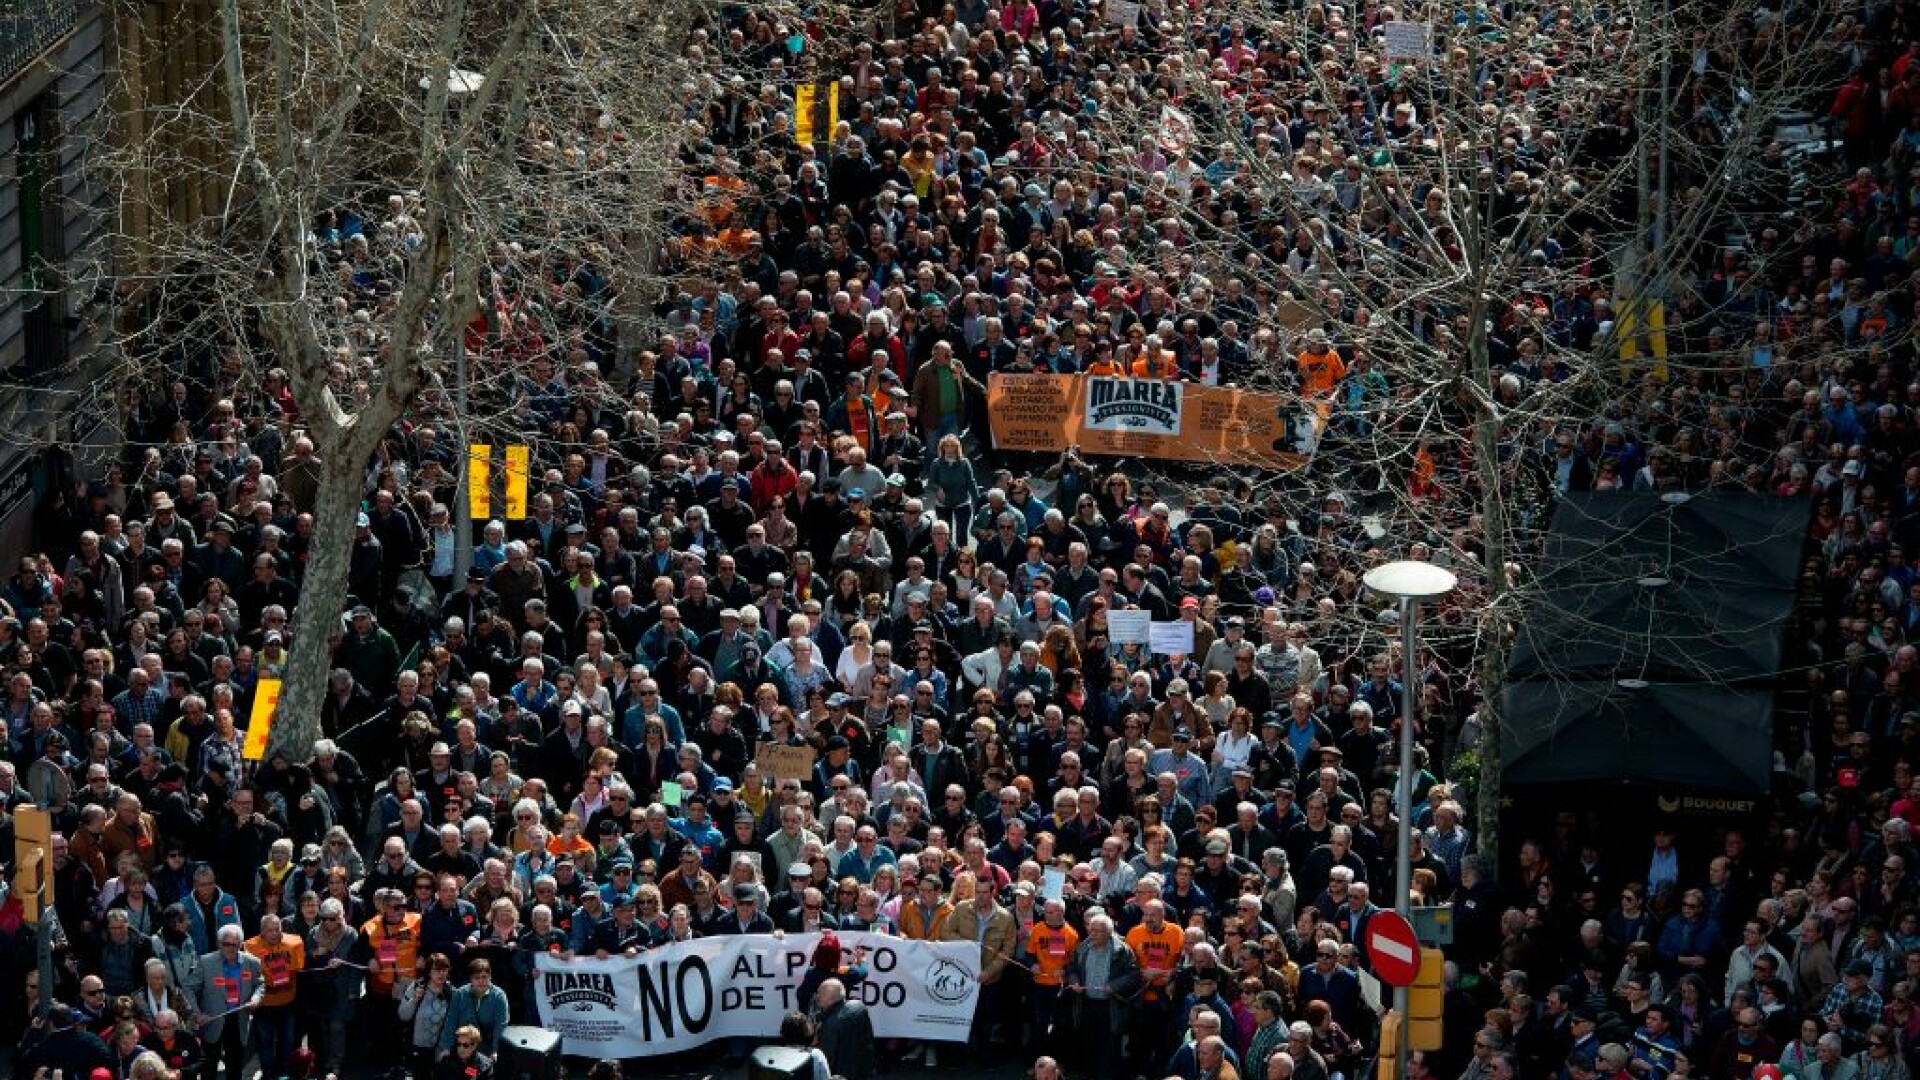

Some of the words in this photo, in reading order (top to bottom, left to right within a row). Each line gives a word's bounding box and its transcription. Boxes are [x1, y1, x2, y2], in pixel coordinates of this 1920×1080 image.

[1091, 379, 1178, 413] MAREA
[1683, 796, 1756, 812] BOUQUET
[731, 954, 775, 980] AL
[786, 945, 897, 978] PTO
[545, 972, 616, 998] MAREA
[637, 954, 713, 1042] NO
[721, 986, 766, 1012] DE
[776, 981, 906, 1010] TEDO
